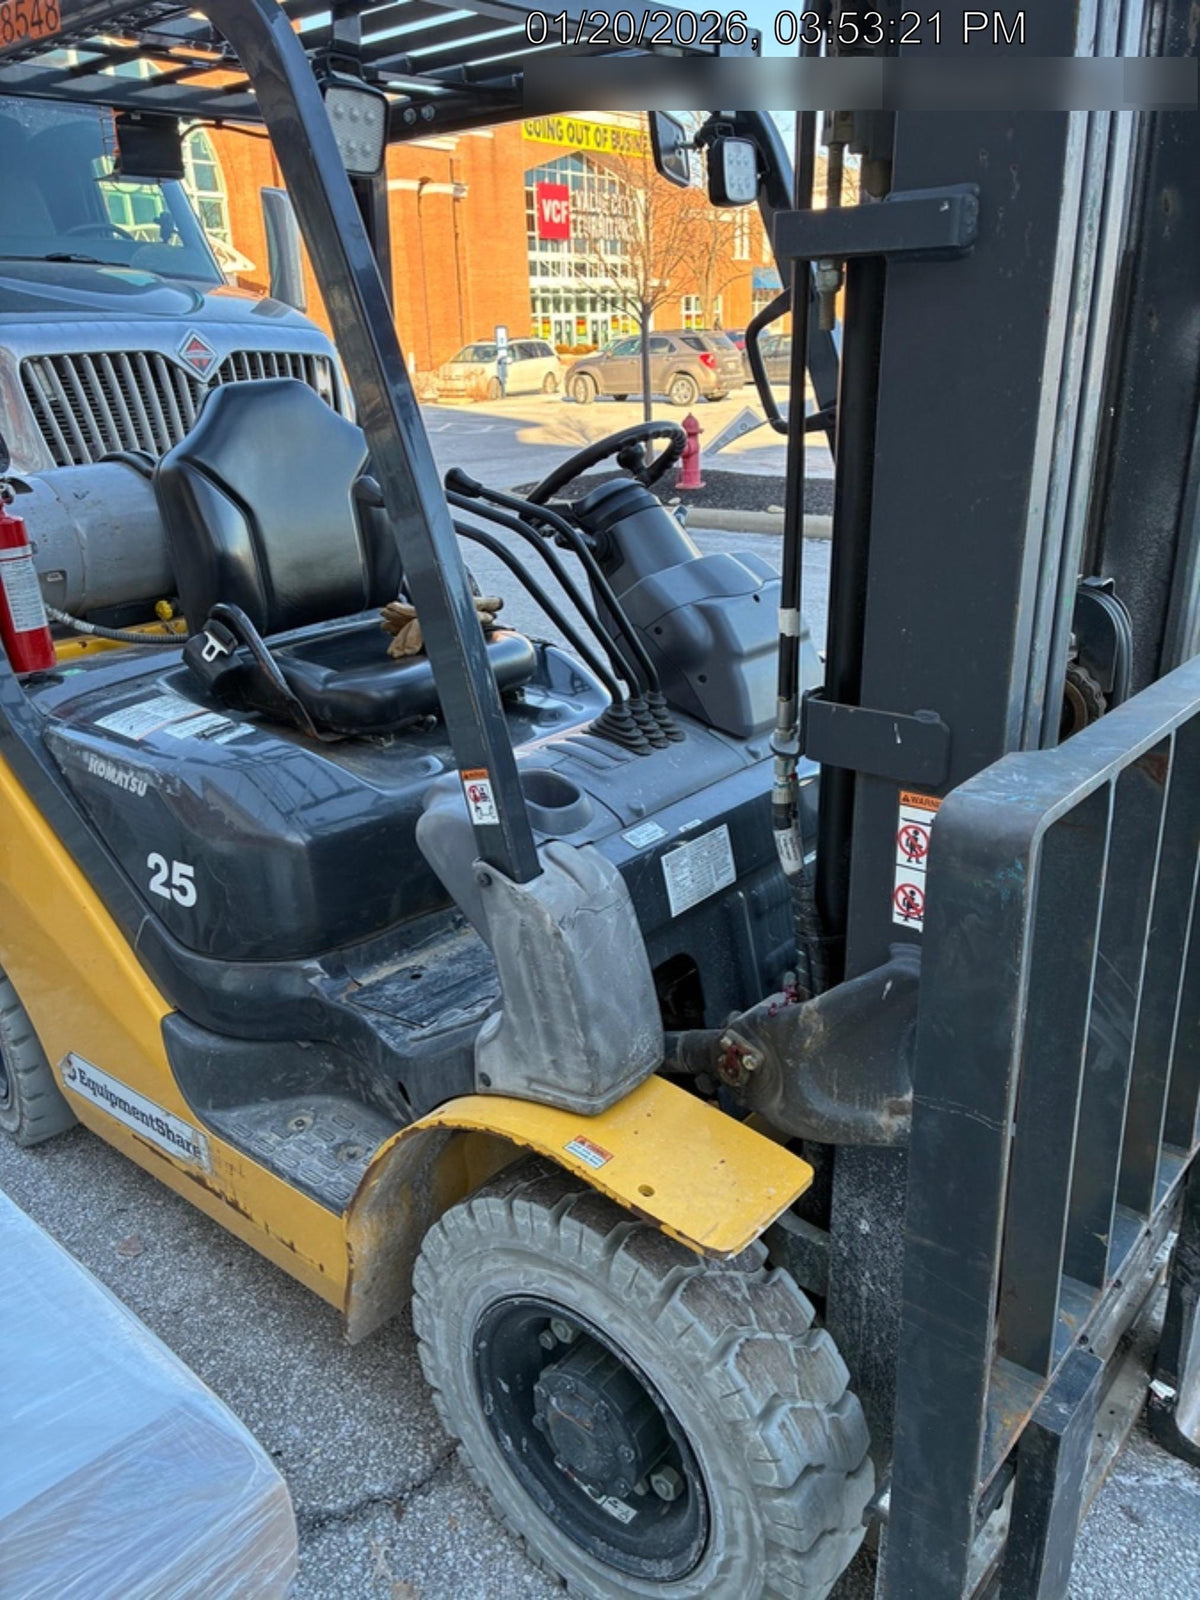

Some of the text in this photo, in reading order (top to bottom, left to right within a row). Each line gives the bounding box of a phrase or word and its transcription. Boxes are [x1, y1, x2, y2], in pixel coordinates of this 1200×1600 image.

[566, 121, 591, 146] OUT
[593, 126, 610, 147] OF
[610, 129, 649, 154] BUSINE
[541, 198, 569, 224] VCF
[88, 755, 148, 797] KOMATSU
[146, 852, 197, 907] 25
[77, 1067, 201, 1159] EquipmentShare
